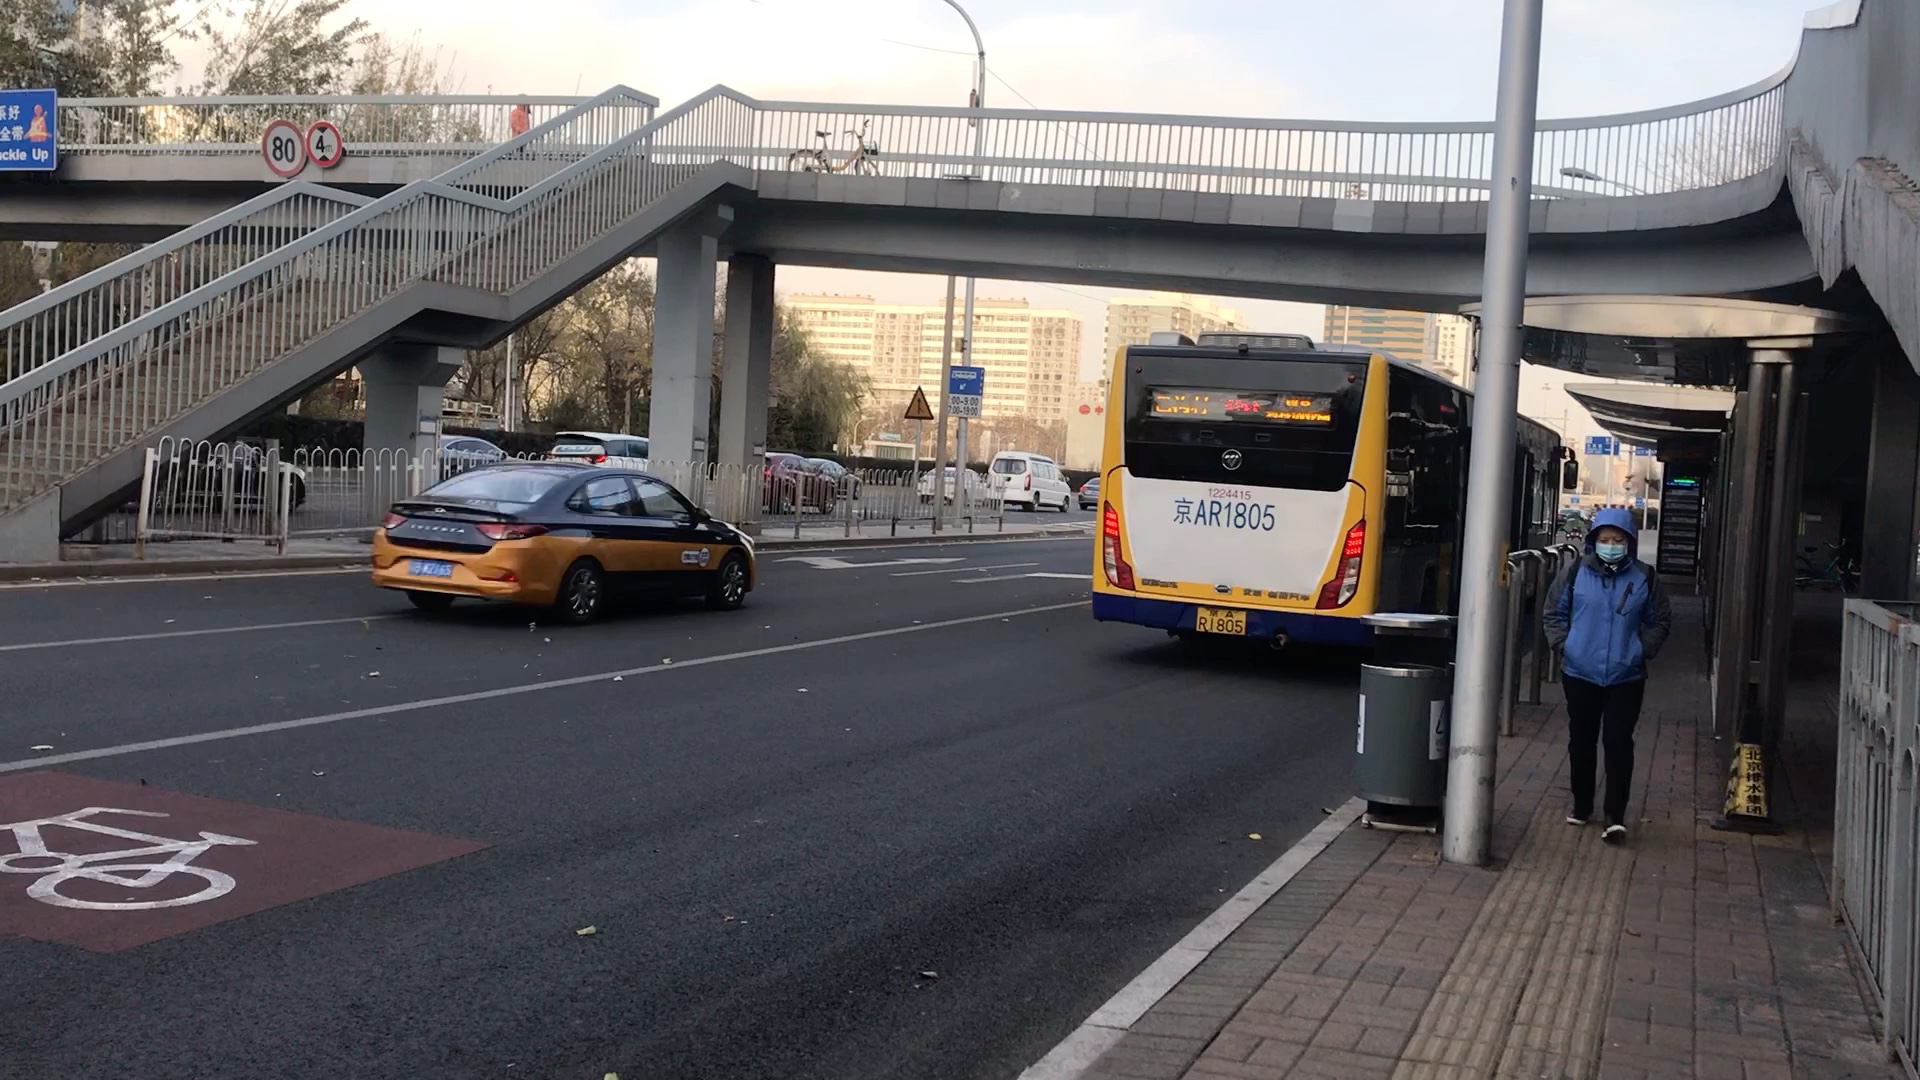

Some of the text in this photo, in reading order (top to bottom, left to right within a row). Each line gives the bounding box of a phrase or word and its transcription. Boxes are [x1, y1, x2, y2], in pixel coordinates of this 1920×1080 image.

[32, 148, 48, 162] Up
[272, 136, 295, 163] 80
[1208, 488, 1252, 500] 1224415
[1173, 497, 1275, 531] 京AR1805
[1198, 616, 1244, 634] R1805
